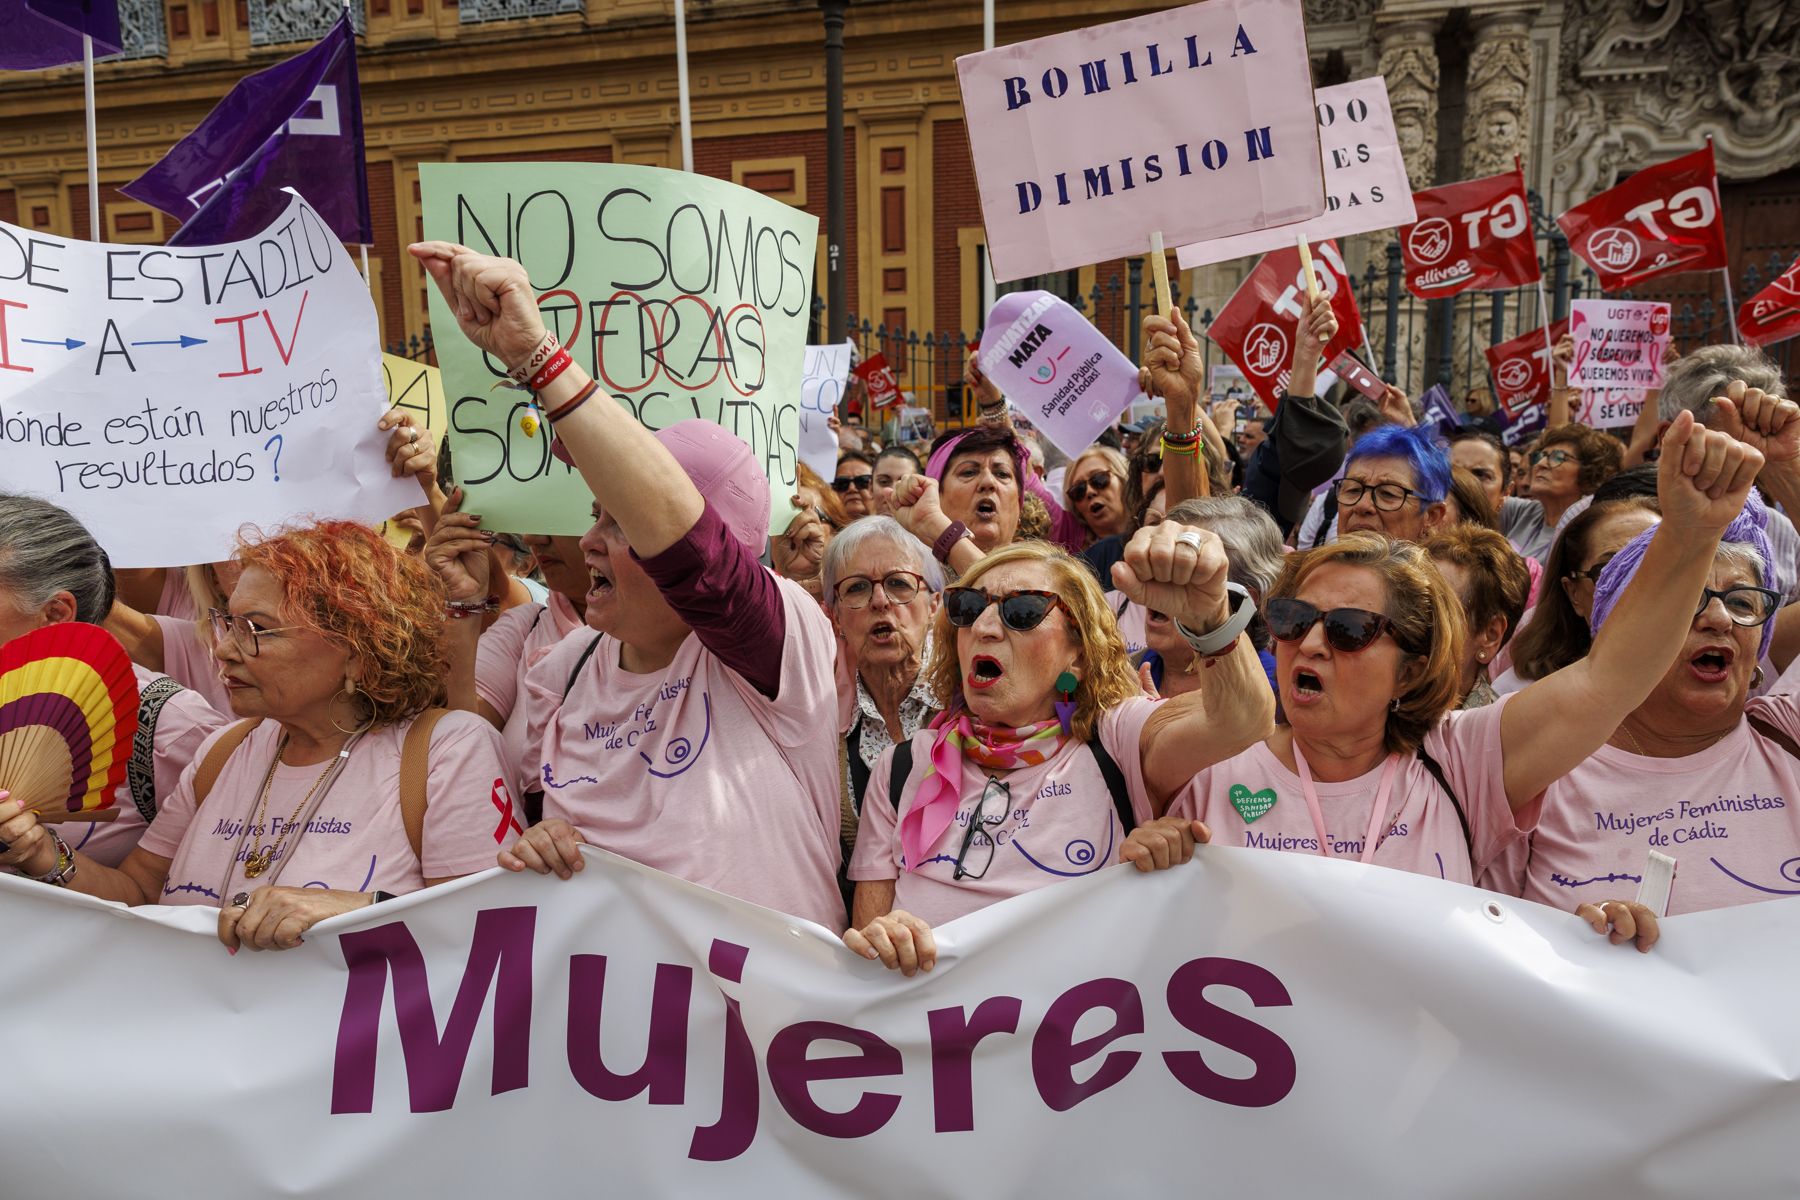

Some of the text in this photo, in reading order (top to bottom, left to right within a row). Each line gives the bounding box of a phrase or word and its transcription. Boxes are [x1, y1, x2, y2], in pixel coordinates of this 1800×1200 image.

[1003, 23, 1258, 111] BONILLA
[1015, 126, 1276, 215] DIMISION
[1331, 143, 1370, 169] ES
[107, 203, 333, 305] ESTADIO
[457, 187, 806, 317] NO SOMOS
[95, 318, 137, 376] A
[215, 290, 309, 378] IV
[1590, 327, 1655, 344] NO QUEREMOS
[1608, 308, 1633, 320] UGT
[1008, 323, 1053, 369] MATA
[1041, 351, 1103, 419] ¡Sanidad Pública
[1057, 391, 1078, 416] para
[1075, 367, 1101, 396] todas!
[1581, 367, 1654, 382] QUEREMOS VIVIR
[103, 398, 204, 445] están
[230, 368, 338, 435] nuestros
[1600, 401, 1645, 419] SE VEN
[605, 733, 623, 750] de
[1595, 794, 1786, 835] Mujeres Feministas
[1648, 821, 1729, 847] de Cádiz
[1246, 831, 1318, 851] Mujeres
[331, 905, 1297, 1162] Mujeres
